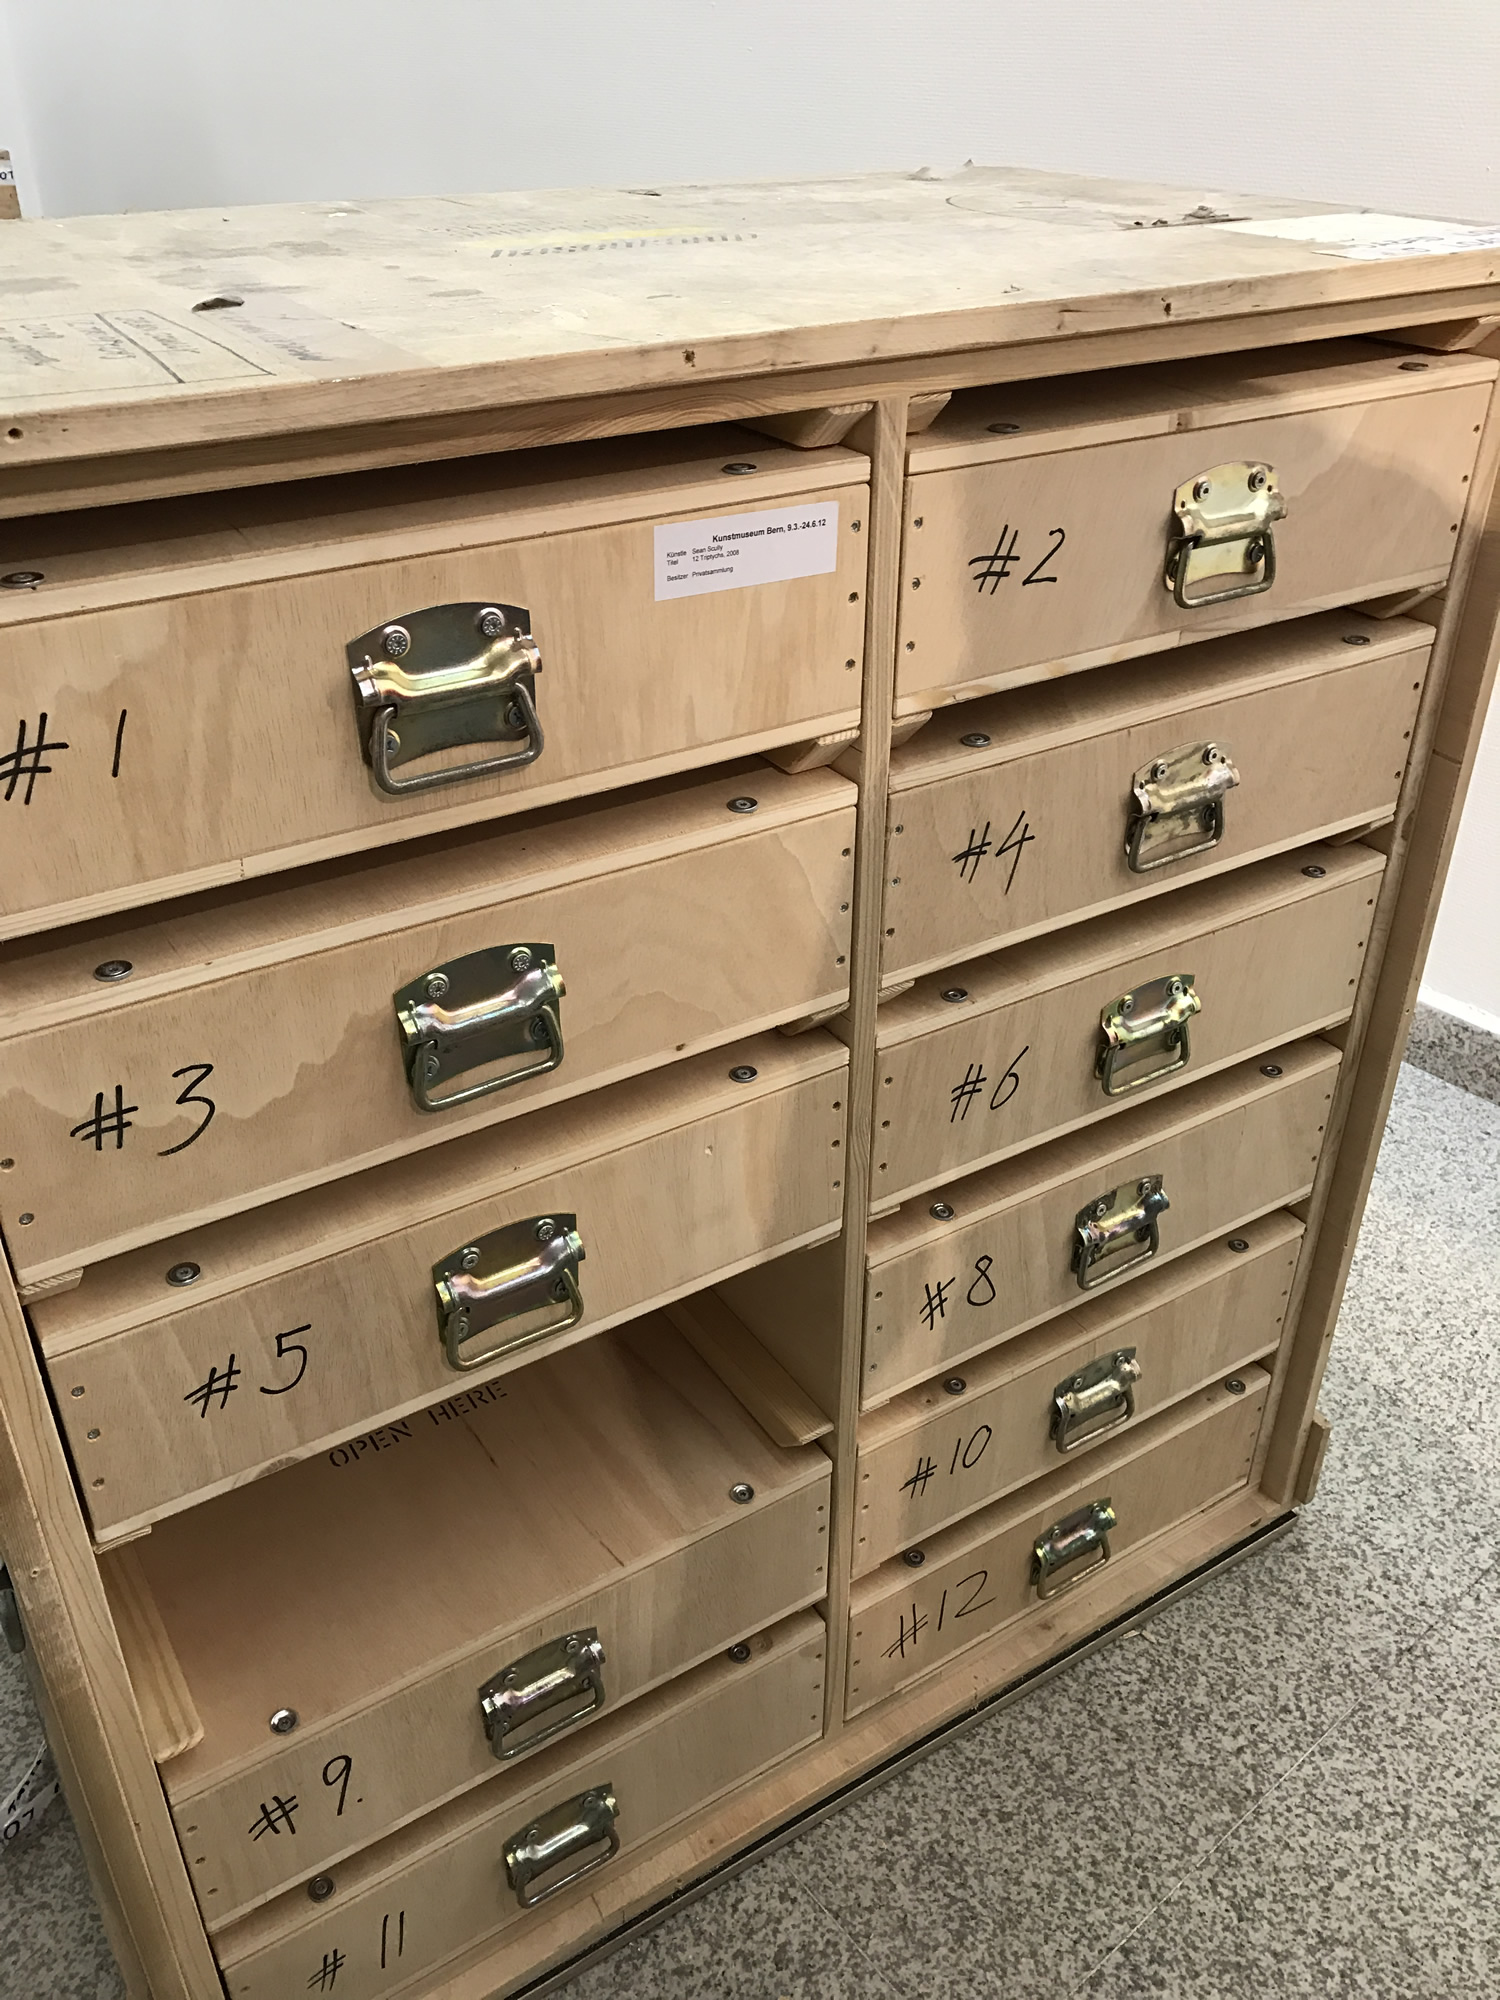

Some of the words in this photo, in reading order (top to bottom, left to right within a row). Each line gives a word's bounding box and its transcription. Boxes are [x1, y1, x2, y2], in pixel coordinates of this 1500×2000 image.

[692, 547, 706, 555] Sean
[707, 544, 723, 552] Scully
[712, 529, 765, 543] Kunstmuseum
[766, 526, 786, 535] Bern,
[787, 518, 827, 532] 9.3.-24.6.12
[726, 549, 740, 557] 2008
[967, 523, 1066, 597] #2
[666, 573, 689, 582] Besitzer
[692, 566, 734, 577] Privatsammlung
[951, 809, 1036, 897] #4
[69, 1063, 216, 1158] #3
[950, 1045, 1030, 1124] #6
[919, 1254, 997, 1332] #8
[183, 1323, 312, 1420] #5
[328, 1420, 413, 1468] OPEN
[427, 1380, 508, 1426] HERE
[899, 1424, 994, 1501] #10
[881, 1569, 998, 1660] #12
